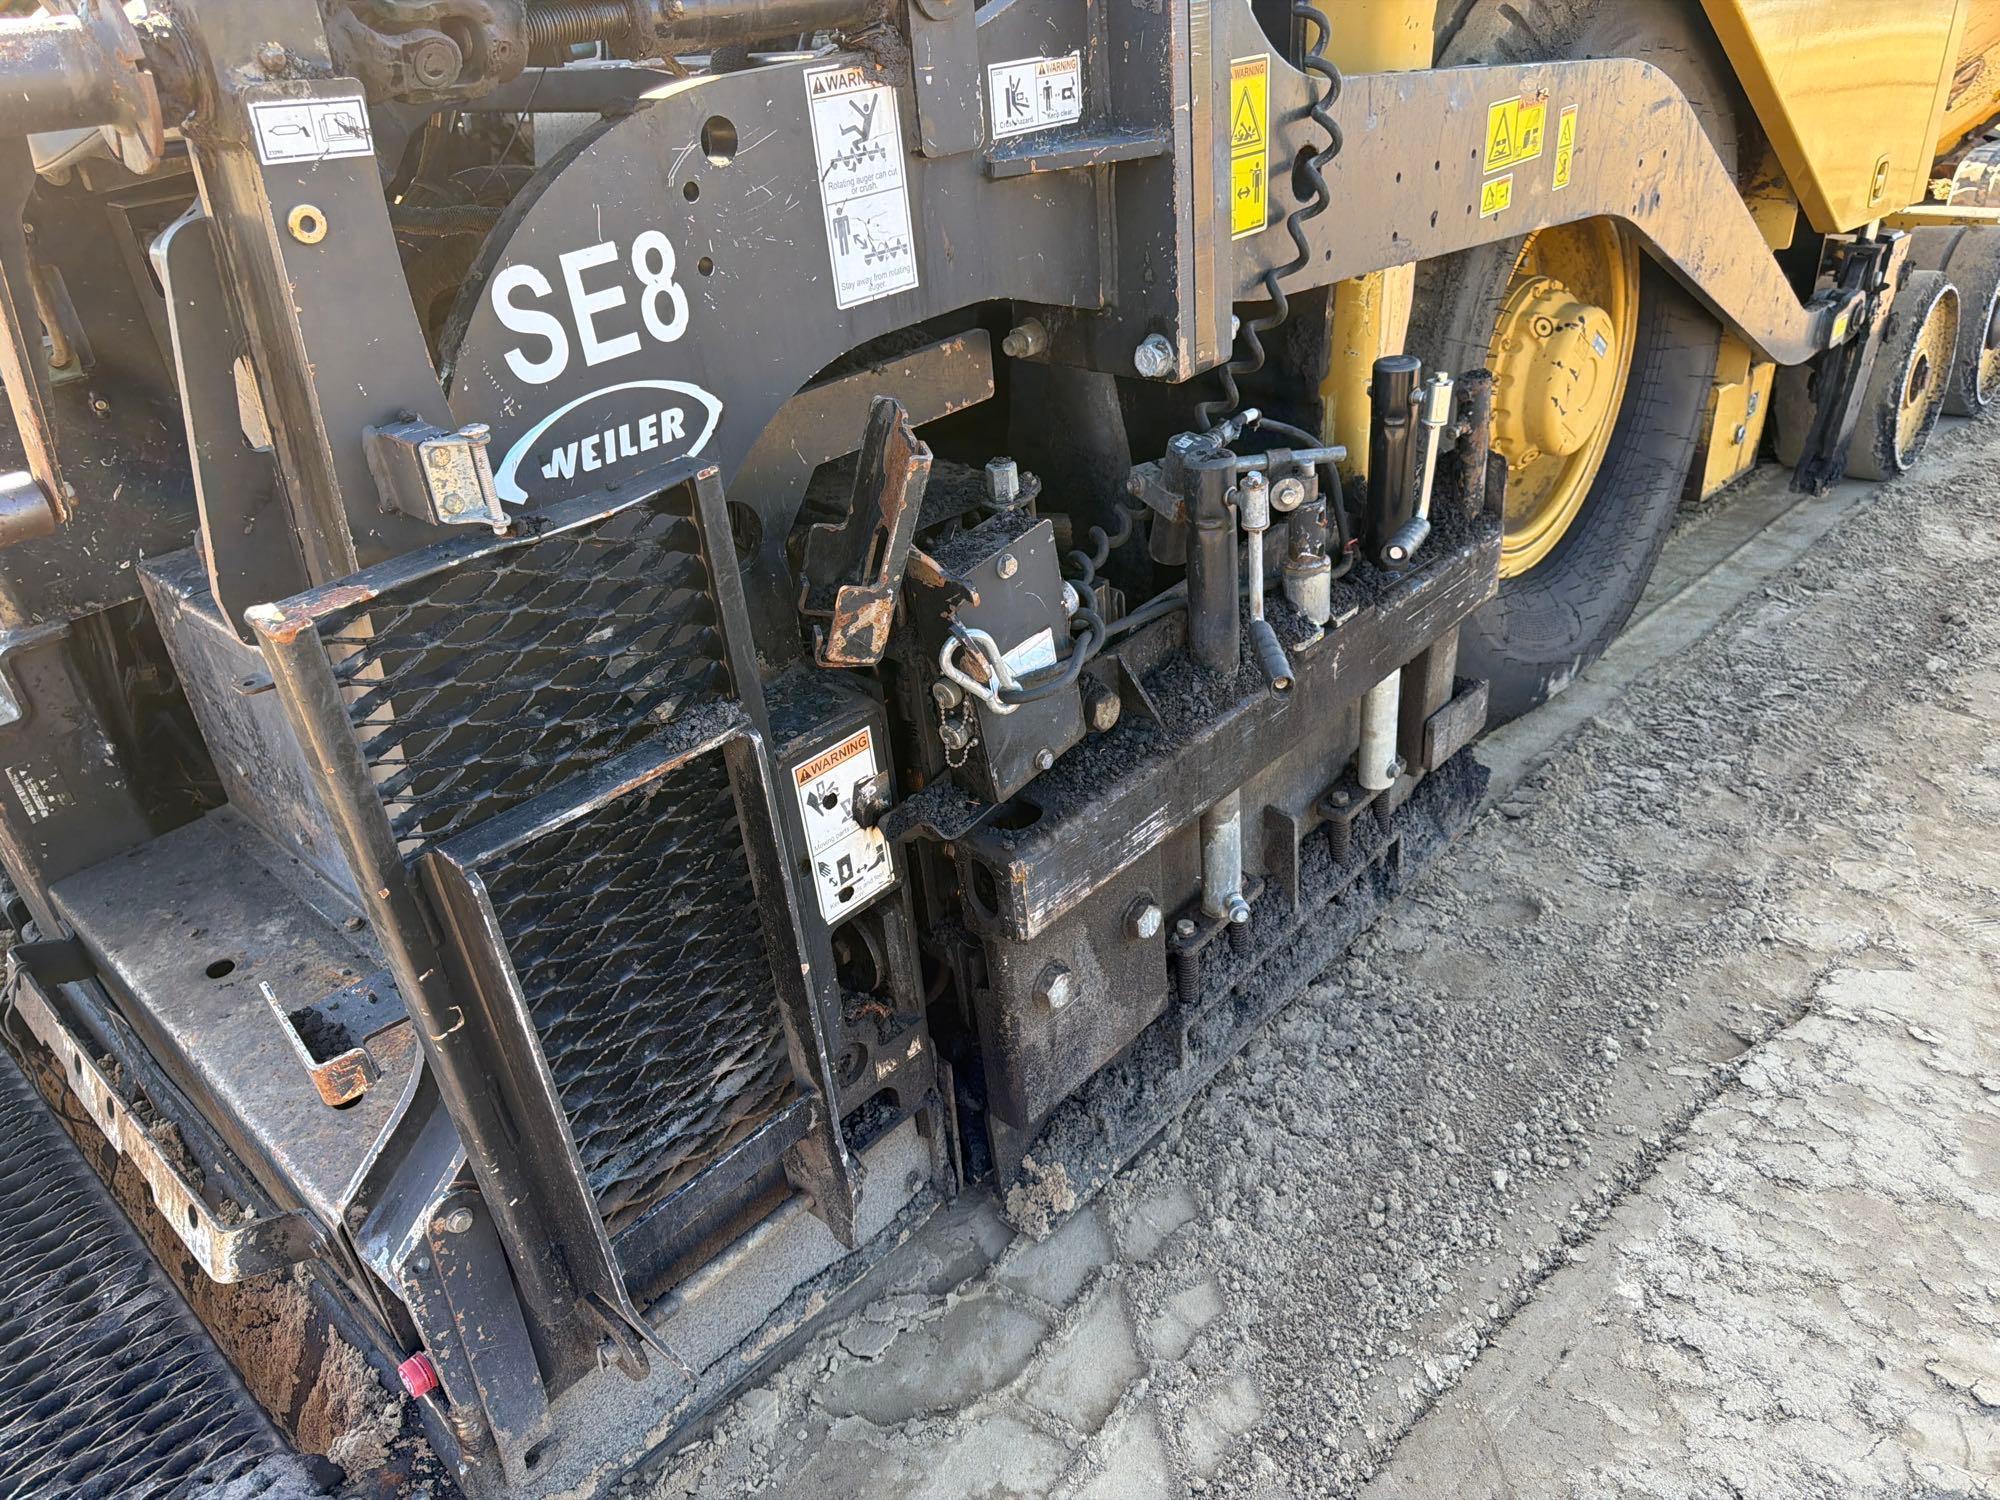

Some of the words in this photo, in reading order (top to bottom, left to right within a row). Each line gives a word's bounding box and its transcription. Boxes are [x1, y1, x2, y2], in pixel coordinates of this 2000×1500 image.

[1046, 59, 1076, 74] WARNING
[1234, 64, 1265, 80] WARNING
[828, 178, 855, 191] Rotating
[856, 174, 874, 185] auger
[875, 171, 887, 180] can
[888, 168, 898, 177] cut
[841, 281, 856, 291] Stay
[874, 273, 888, 281] from
[889, 265, 911, 278] rotating
[491, 230, 690, 385] SE8
[541, 407, 686, 480] WEILER
[811, 736, 867, 775] WARNING
[814, 836, 835, 851] Moving
[836, 827, 850, 840] parts
